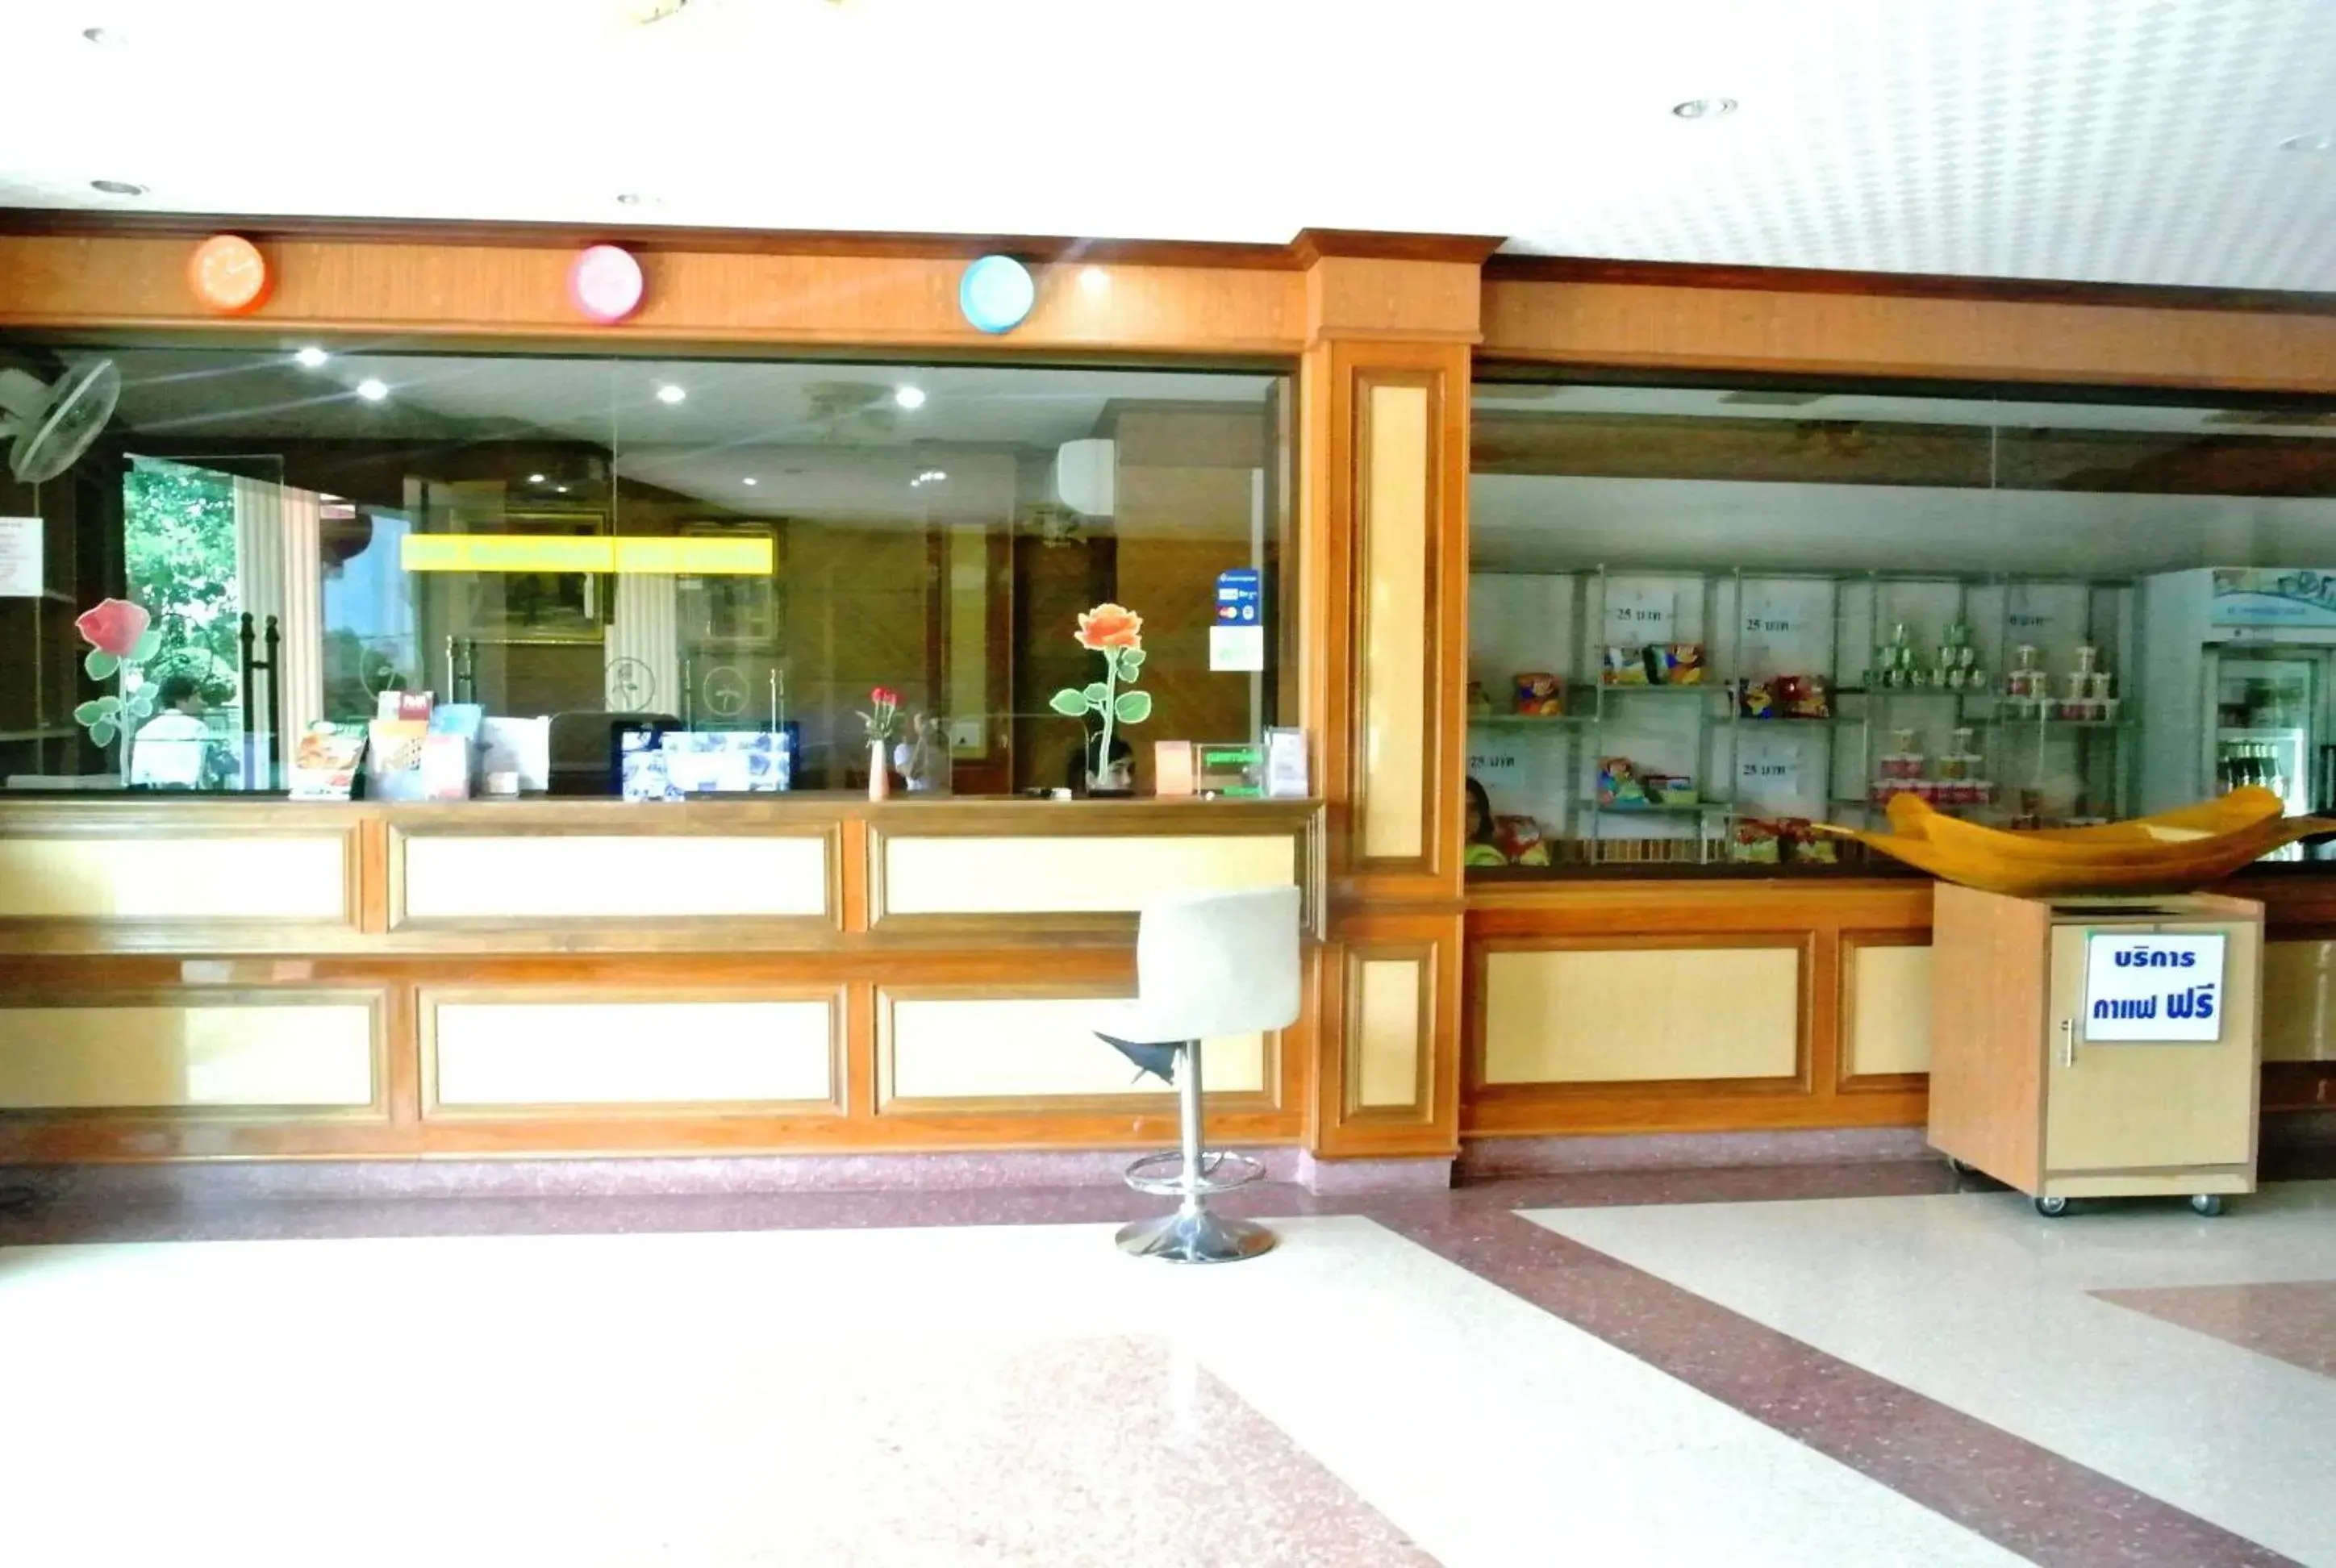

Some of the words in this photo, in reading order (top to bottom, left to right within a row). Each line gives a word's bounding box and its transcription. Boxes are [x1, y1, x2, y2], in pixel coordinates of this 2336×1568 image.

[2114, 945, 2196, 968] บริการ
[2092, 994, 2158, 1020] กาแฟ
[2167, 982, 2215, 1019] ฟรี
